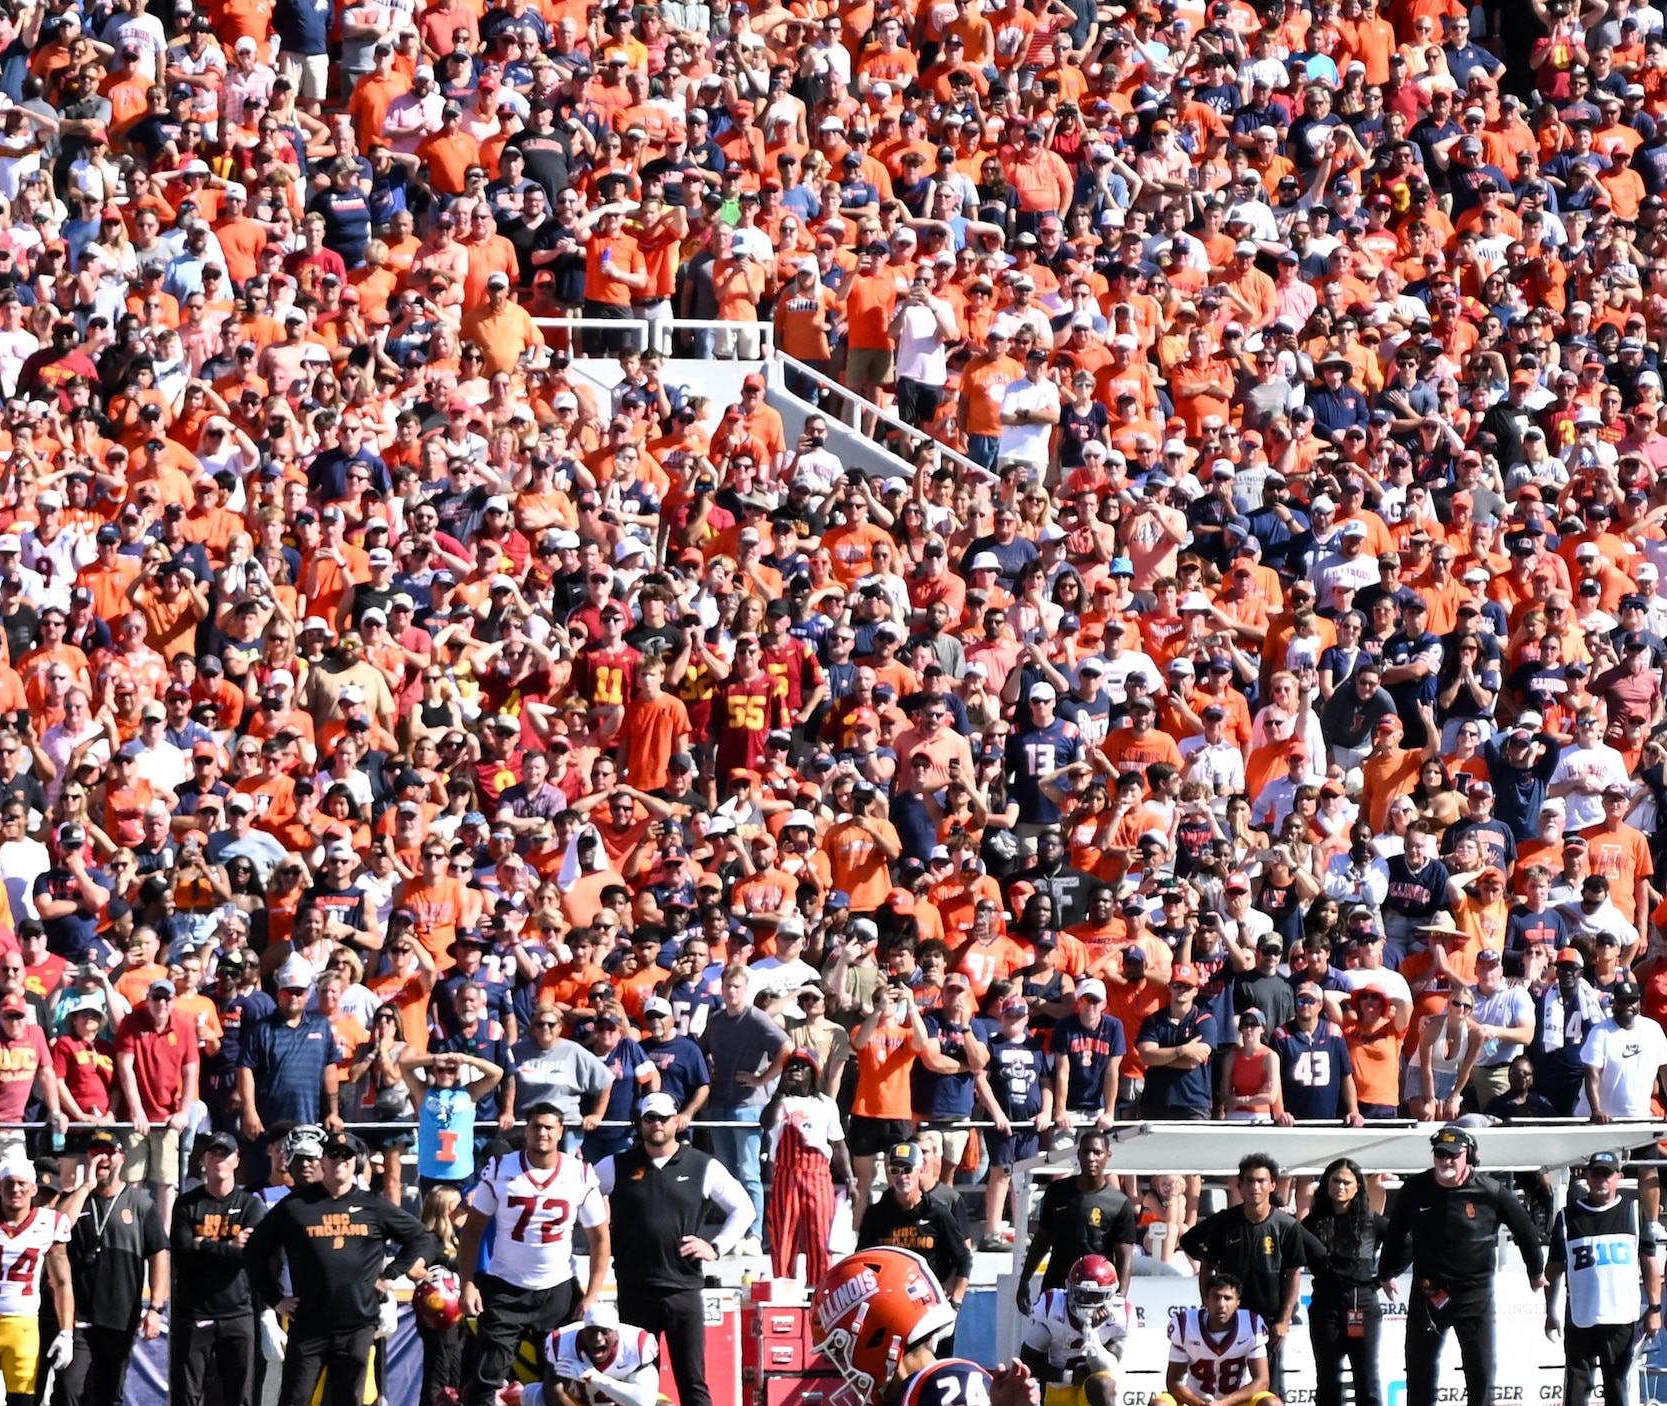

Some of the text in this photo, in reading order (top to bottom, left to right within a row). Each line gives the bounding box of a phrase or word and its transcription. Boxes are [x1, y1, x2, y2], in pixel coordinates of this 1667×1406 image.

[596, 666, 622, 704] 11
[728, 695, 766, 730] 55
[1026, 743, 1055, 777] 13
[1294, 1051, 1331, 1086] 43
[435, 1131, 460, 1163] I
[305, 1224, 369, 1238] TROJANS
[322, 1213, 351, 1228] USC
[507, 1196, 571, 1244] 72
[818, 1271, 880, 1331] ILLINOIS
[1189, 1357, 1248, 1398] 48
